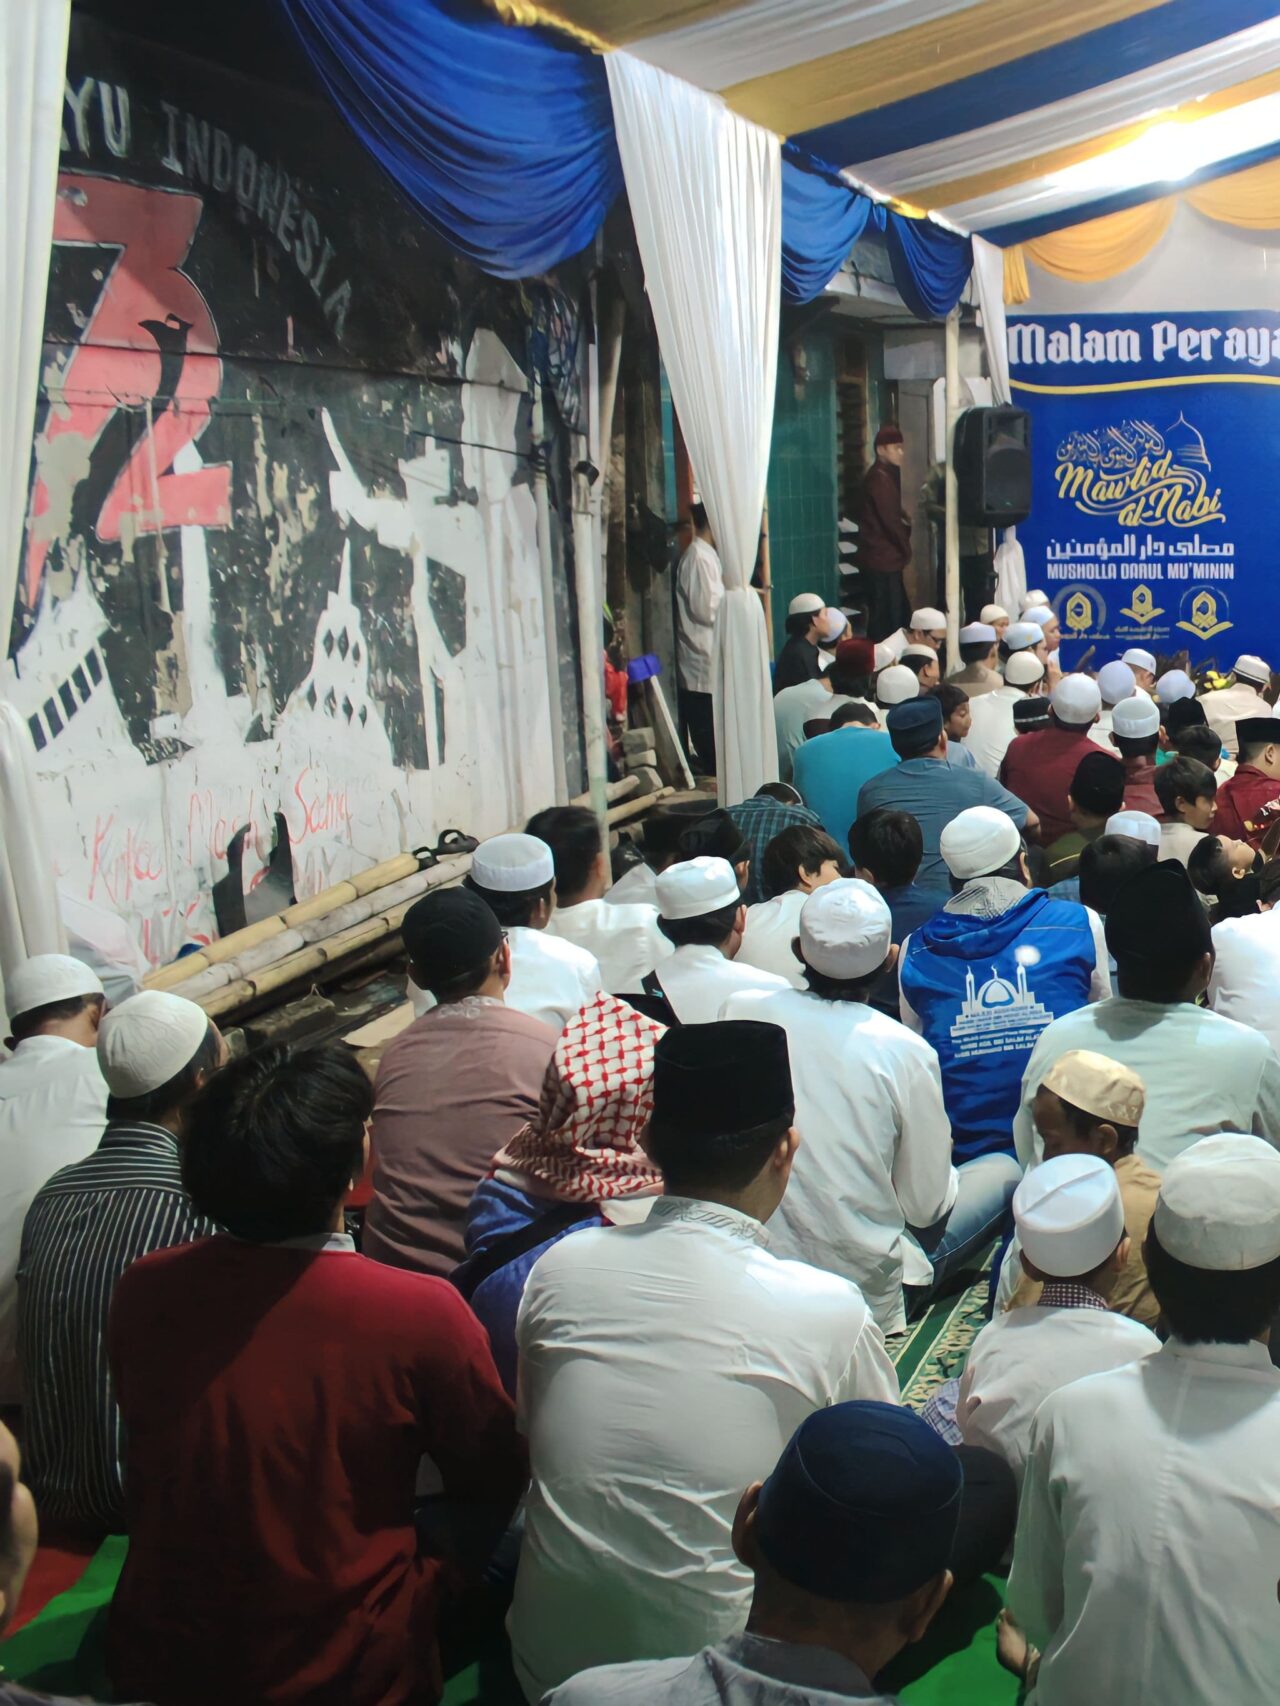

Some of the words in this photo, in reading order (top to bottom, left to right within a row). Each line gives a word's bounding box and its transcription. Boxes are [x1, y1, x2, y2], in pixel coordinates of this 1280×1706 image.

[160, 100, 351, 341] INDONESIA
[1007, 322, 1142, 364] Malam
[1055, 450, 1178, 506] Mawlid
[1117, 484, 1226, 528] al-Nabi
[1046, 534, 1136, 561] المؤمنين
[1139, 534, 1166, 561] دار
[1047, 563, 1117, 580] MUSHOLLA
[1120, 563, 1164, 580] DARUL
[1167, 562, 1235, 580] MU'MININ
